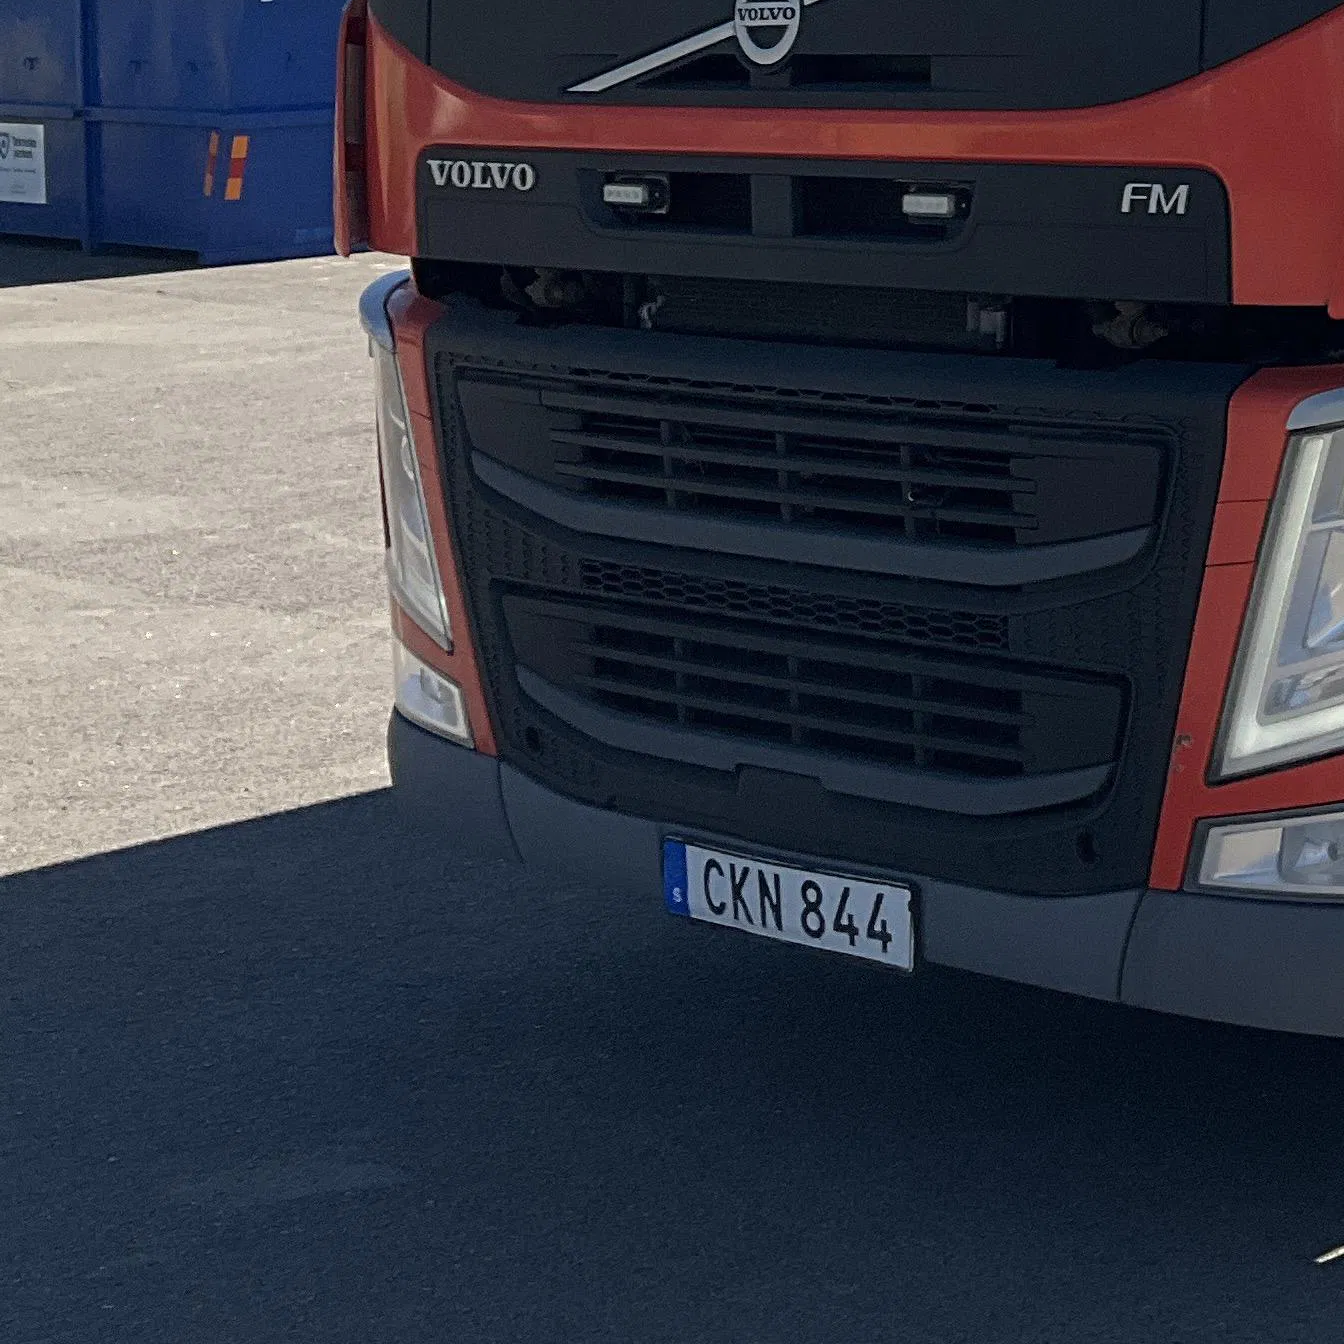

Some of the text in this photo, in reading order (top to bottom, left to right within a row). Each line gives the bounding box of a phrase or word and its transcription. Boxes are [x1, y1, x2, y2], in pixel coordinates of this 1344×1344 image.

[737, 7, 797, 21] VOLVO
[426, 159, 535, 191] VOLVO
[1121, 183, 1189, 215] FM
[671, 886, 683, 904] S
[703, 857, 893, 954] CKN 844
